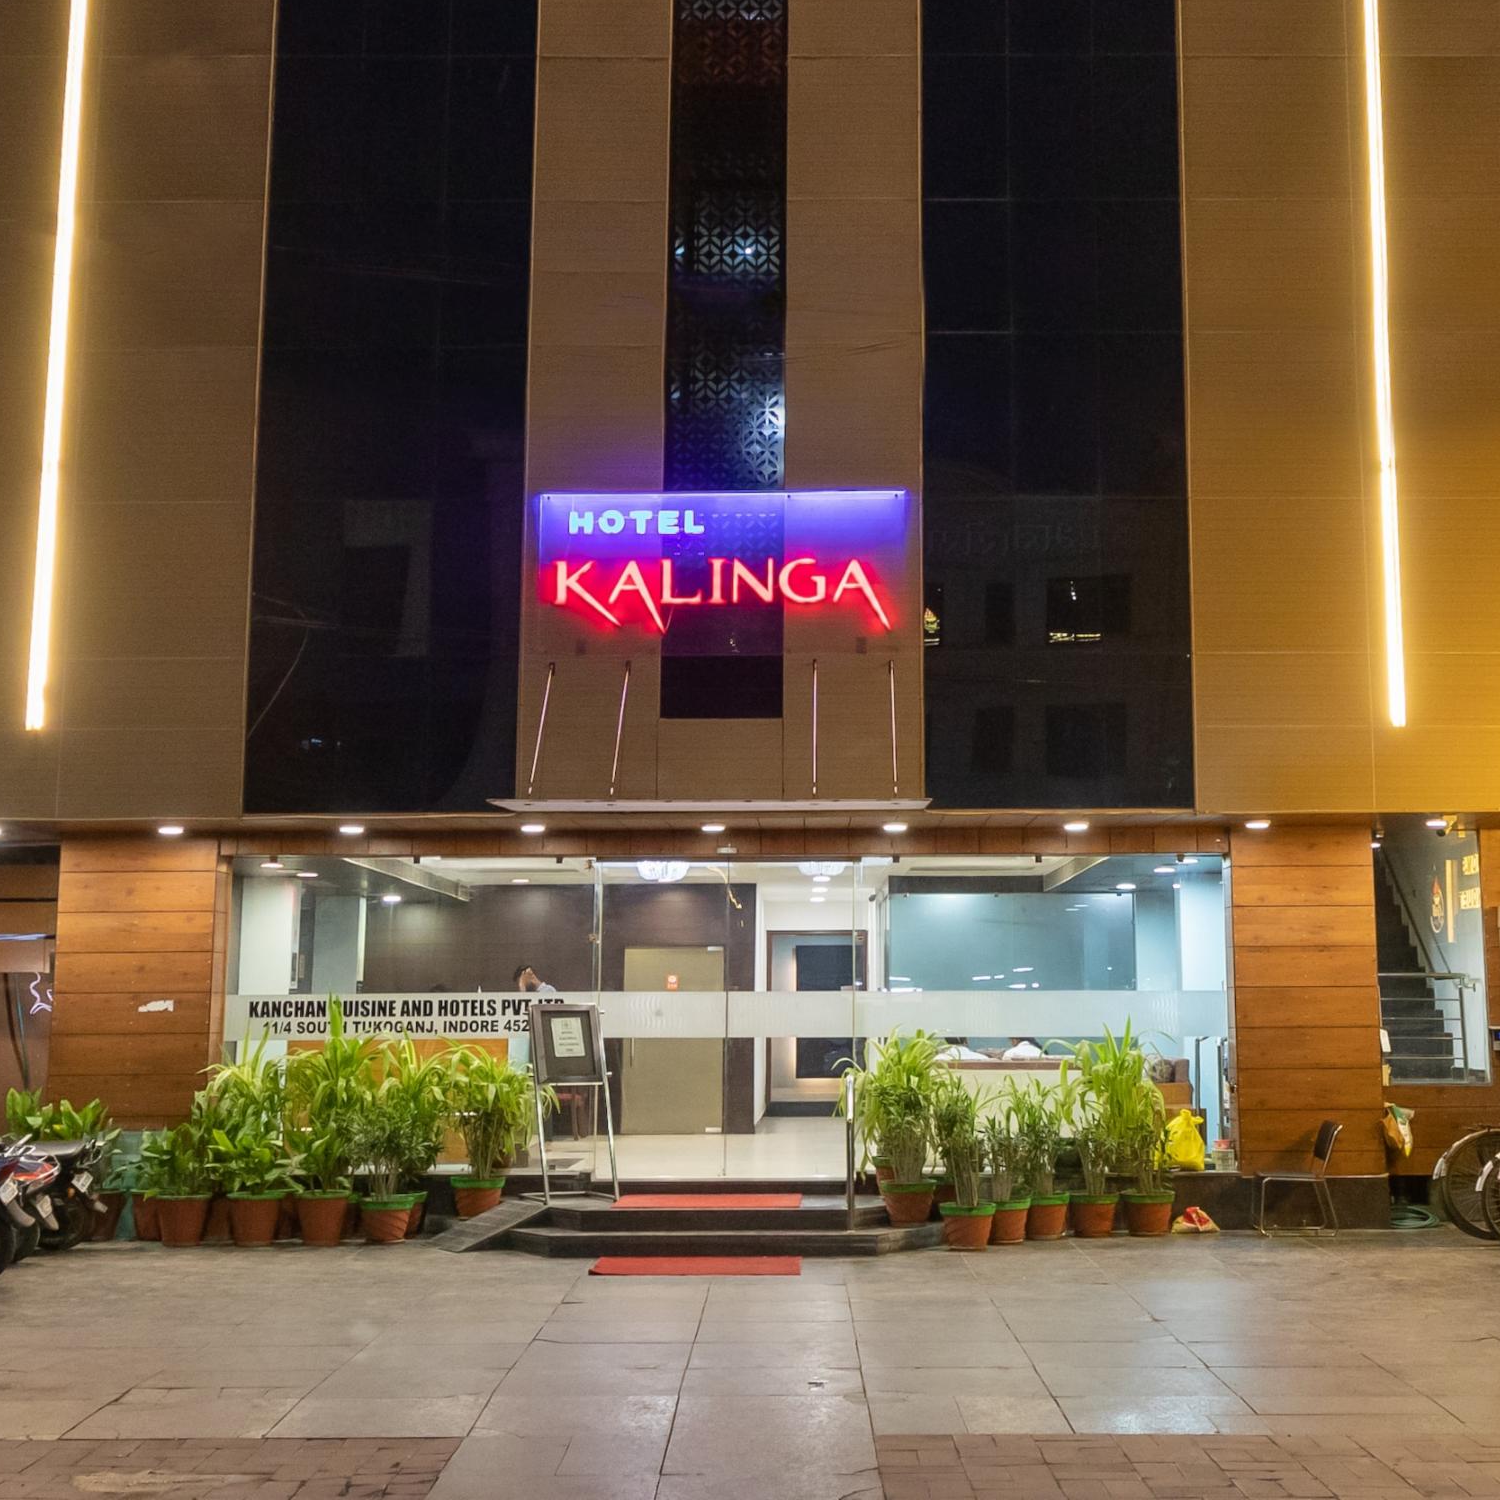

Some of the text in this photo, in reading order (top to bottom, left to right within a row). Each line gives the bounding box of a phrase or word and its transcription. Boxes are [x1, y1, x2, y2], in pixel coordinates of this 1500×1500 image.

[568, 509, 705, 535] HOTEL
[553, 557, 893, 634] KALINGA
[250, 1000, 327, 1018] KANCHAN
[334, 1000, 397, 1018] UISINE
[400, 999, 433, 1017] AND
[438, 999, 497, 1017] HOTELS
[443, 1019, 499, 1033] INDORE
